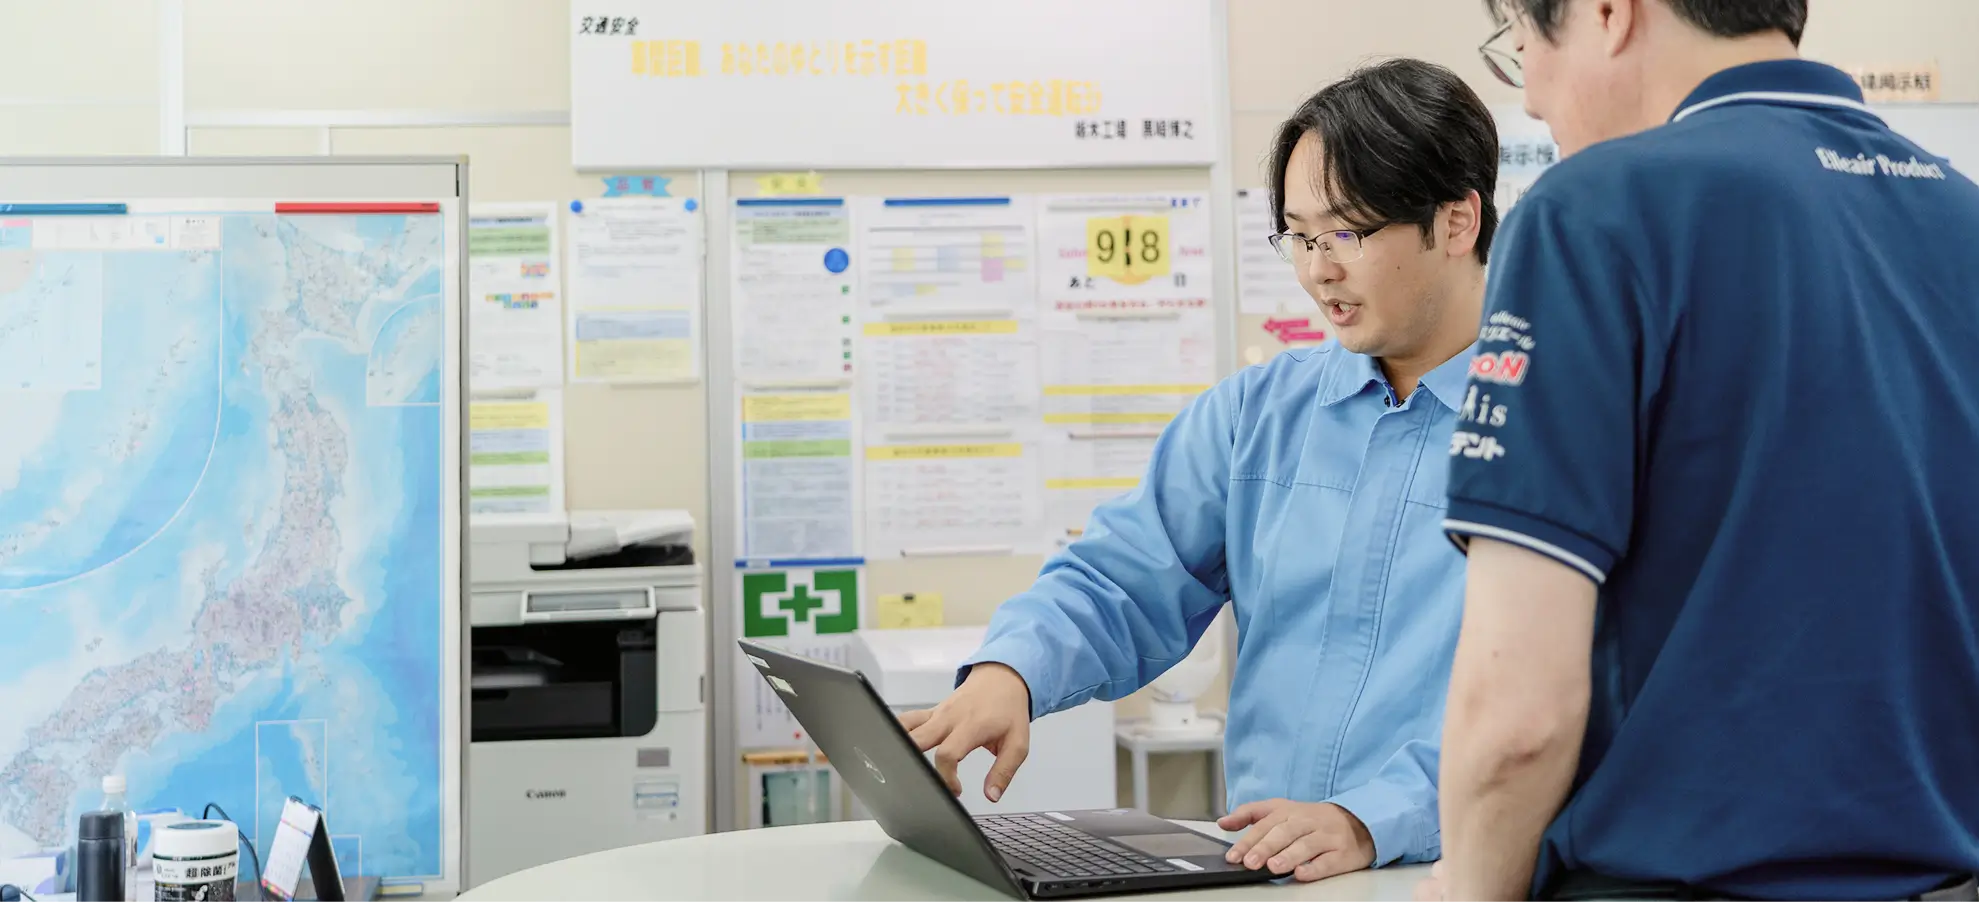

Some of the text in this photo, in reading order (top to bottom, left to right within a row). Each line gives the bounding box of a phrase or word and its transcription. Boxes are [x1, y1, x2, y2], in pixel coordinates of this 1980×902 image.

[579, 16, 639, 36] 交通安全
[1875, 153, 1947, 180] Product
[524, 789, 567, 801] Canon
